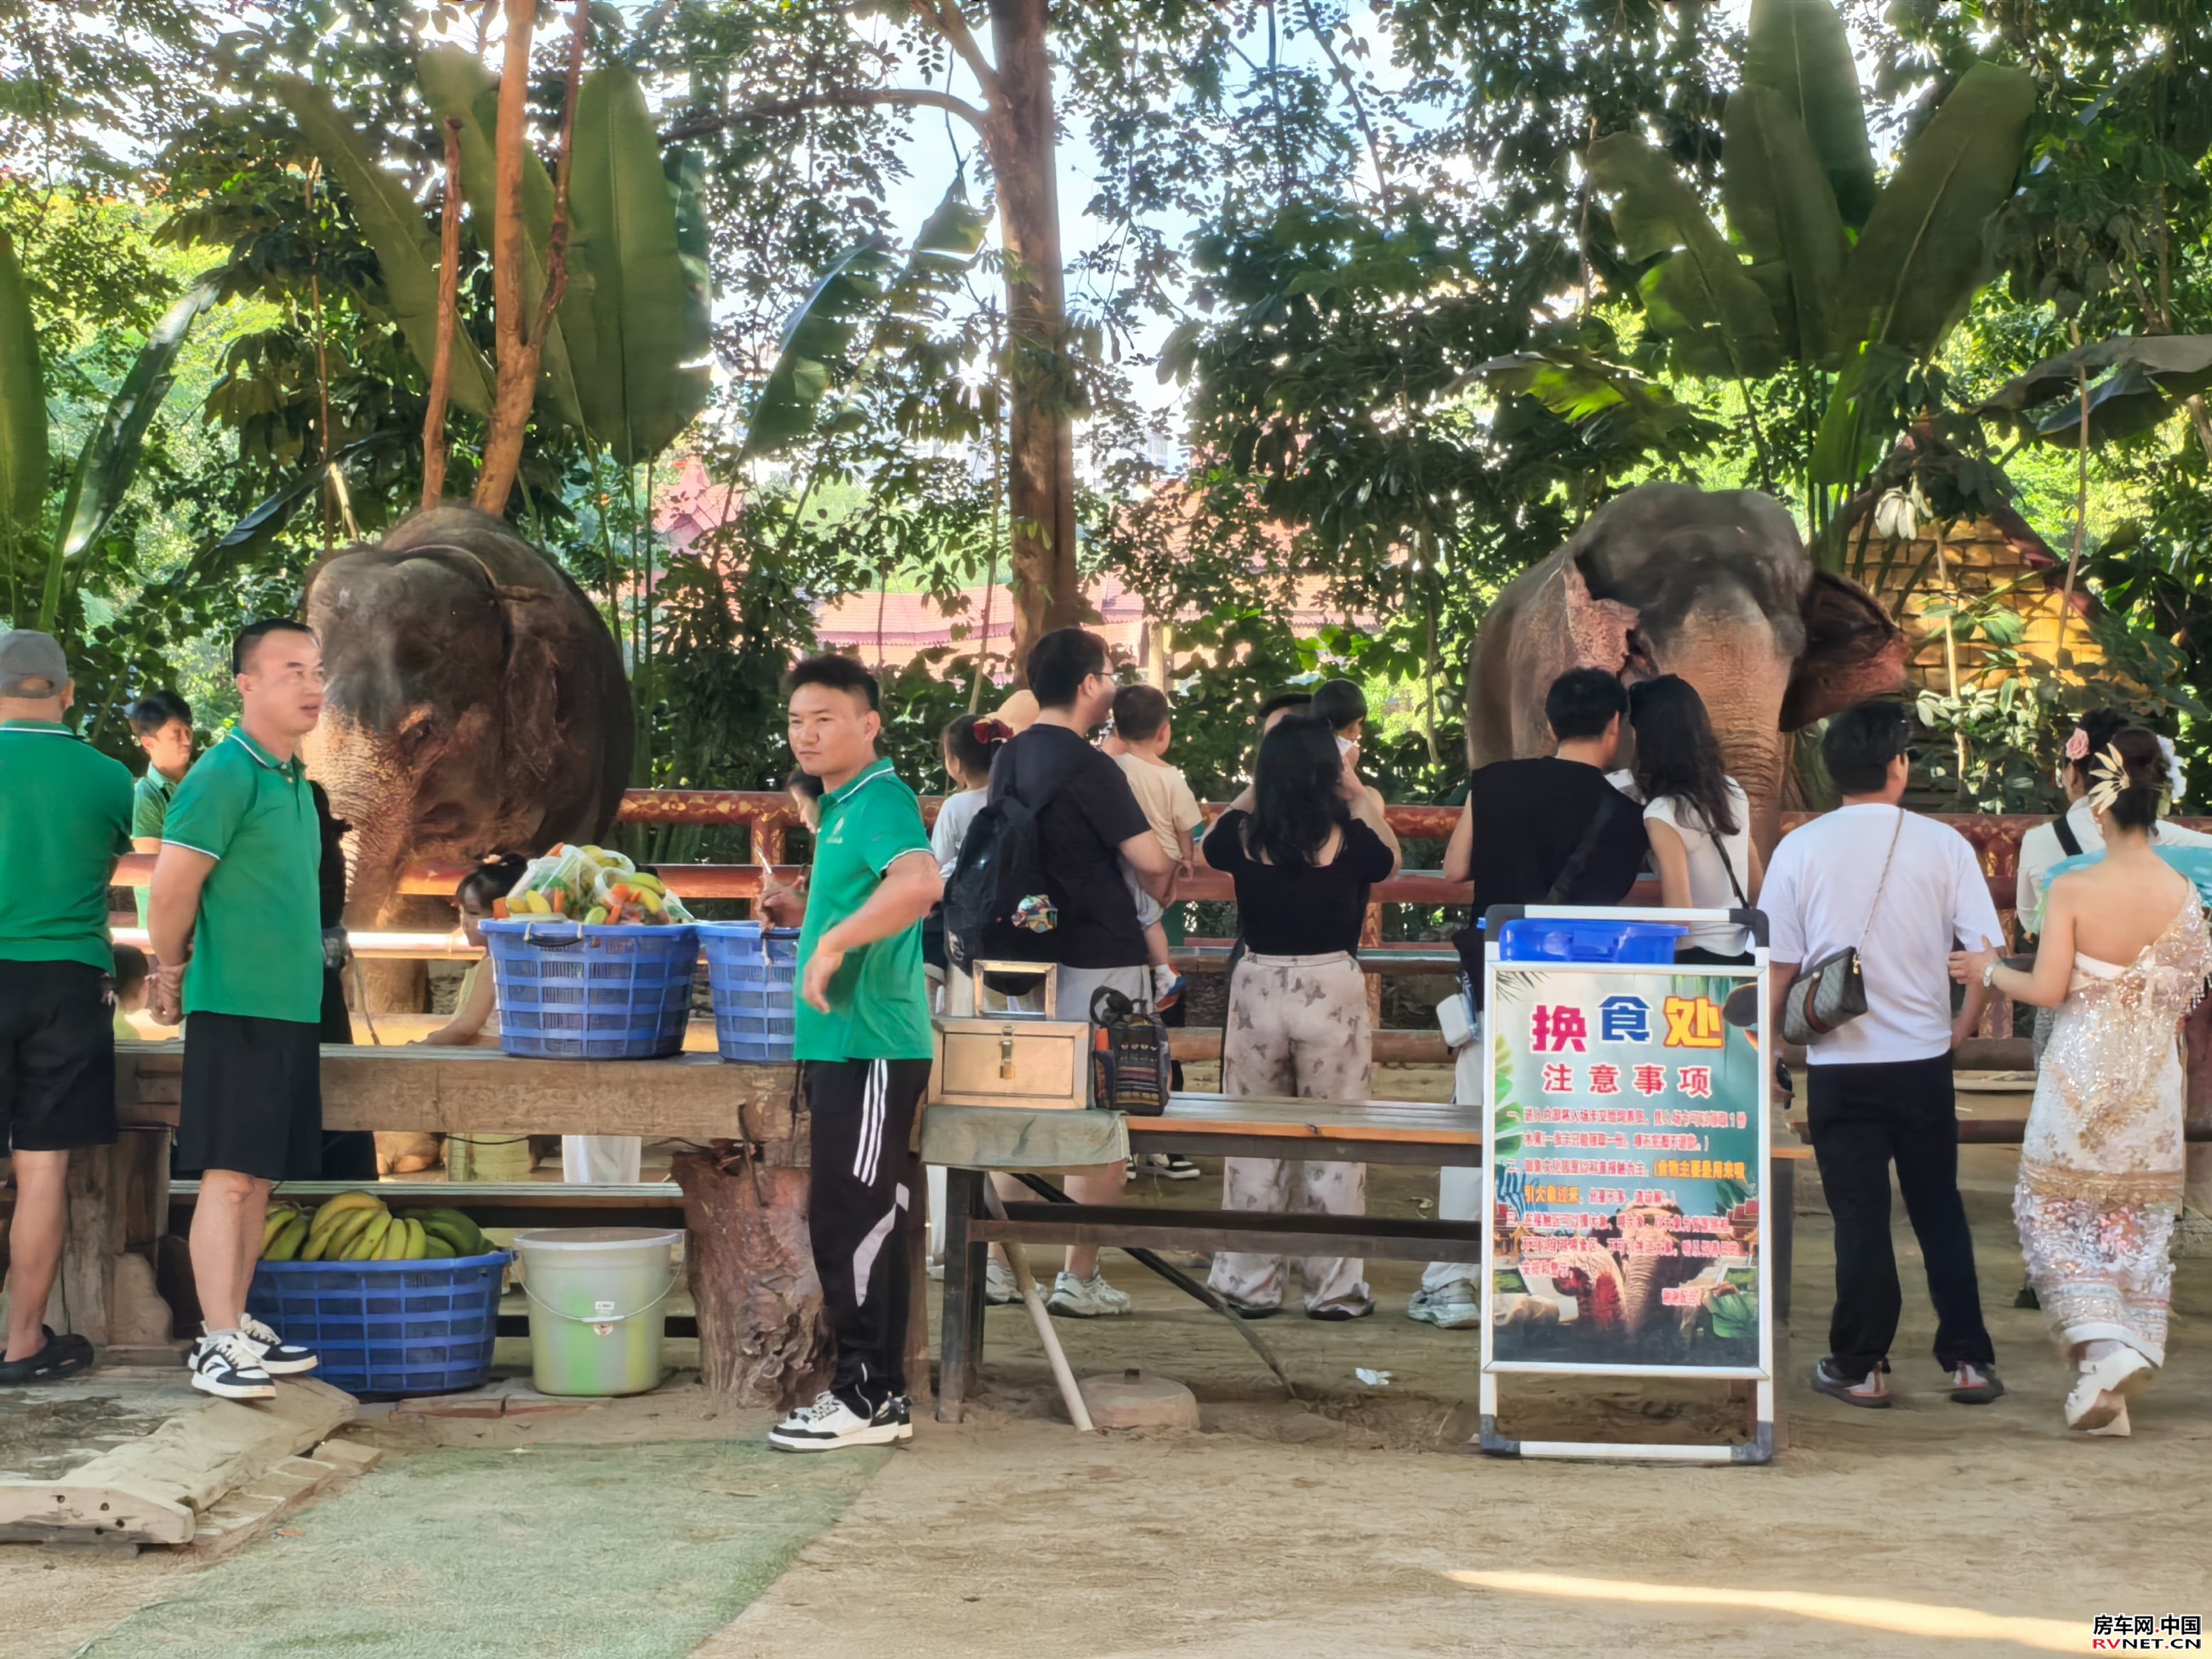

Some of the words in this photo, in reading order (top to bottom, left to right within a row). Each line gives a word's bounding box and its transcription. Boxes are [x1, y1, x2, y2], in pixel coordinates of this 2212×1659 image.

[1531, 994, 1724, 1052] 换食处
[1543, 1063, 1712, 1097] 注意事项
